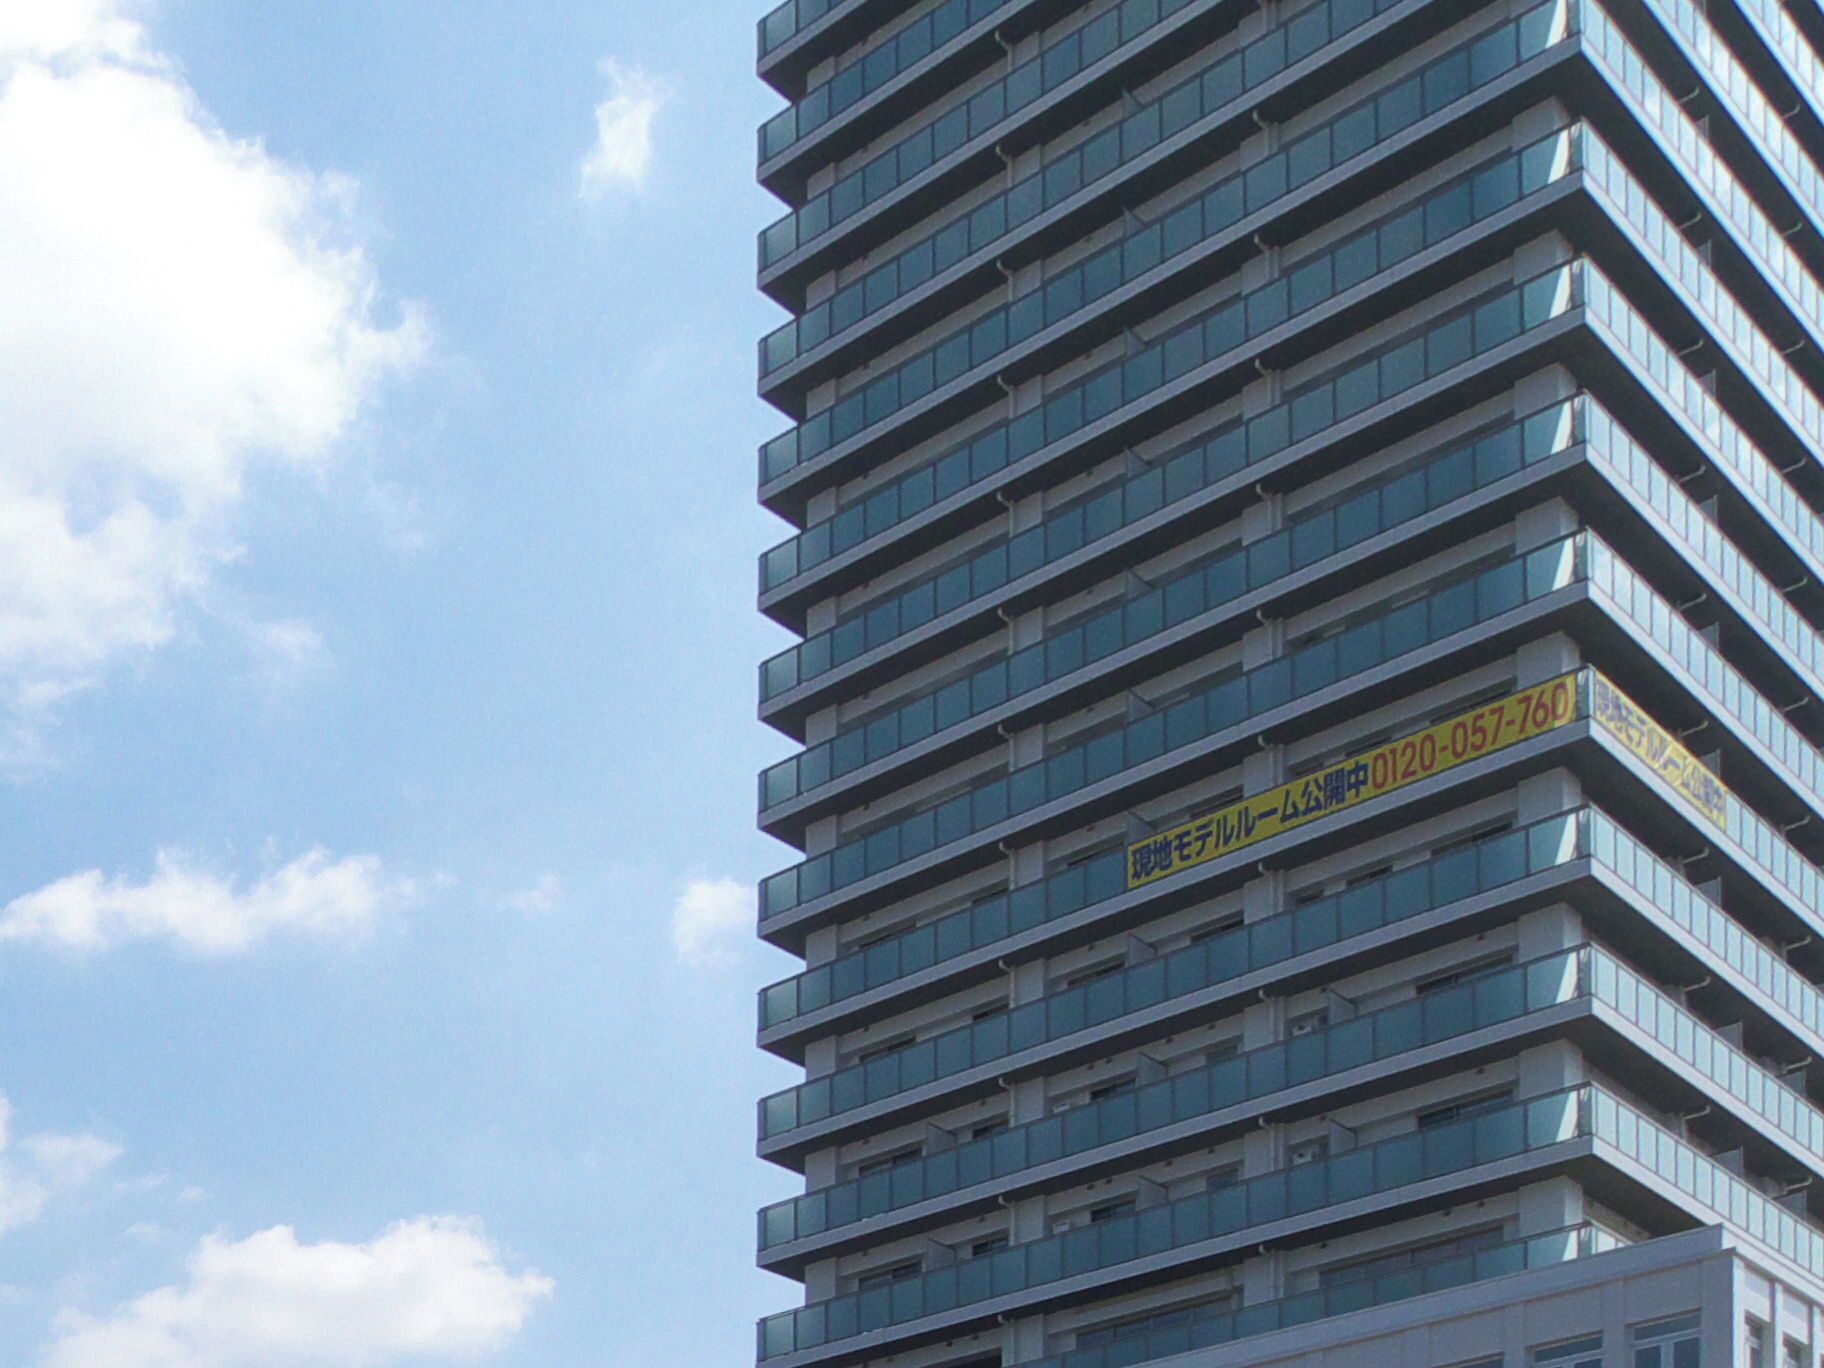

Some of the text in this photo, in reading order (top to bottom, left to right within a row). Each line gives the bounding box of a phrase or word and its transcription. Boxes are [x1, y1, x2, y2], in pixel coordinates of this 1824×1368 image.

[1130, 682, 1569, 881] 現地モデルルーム公開中 0120-057-760
